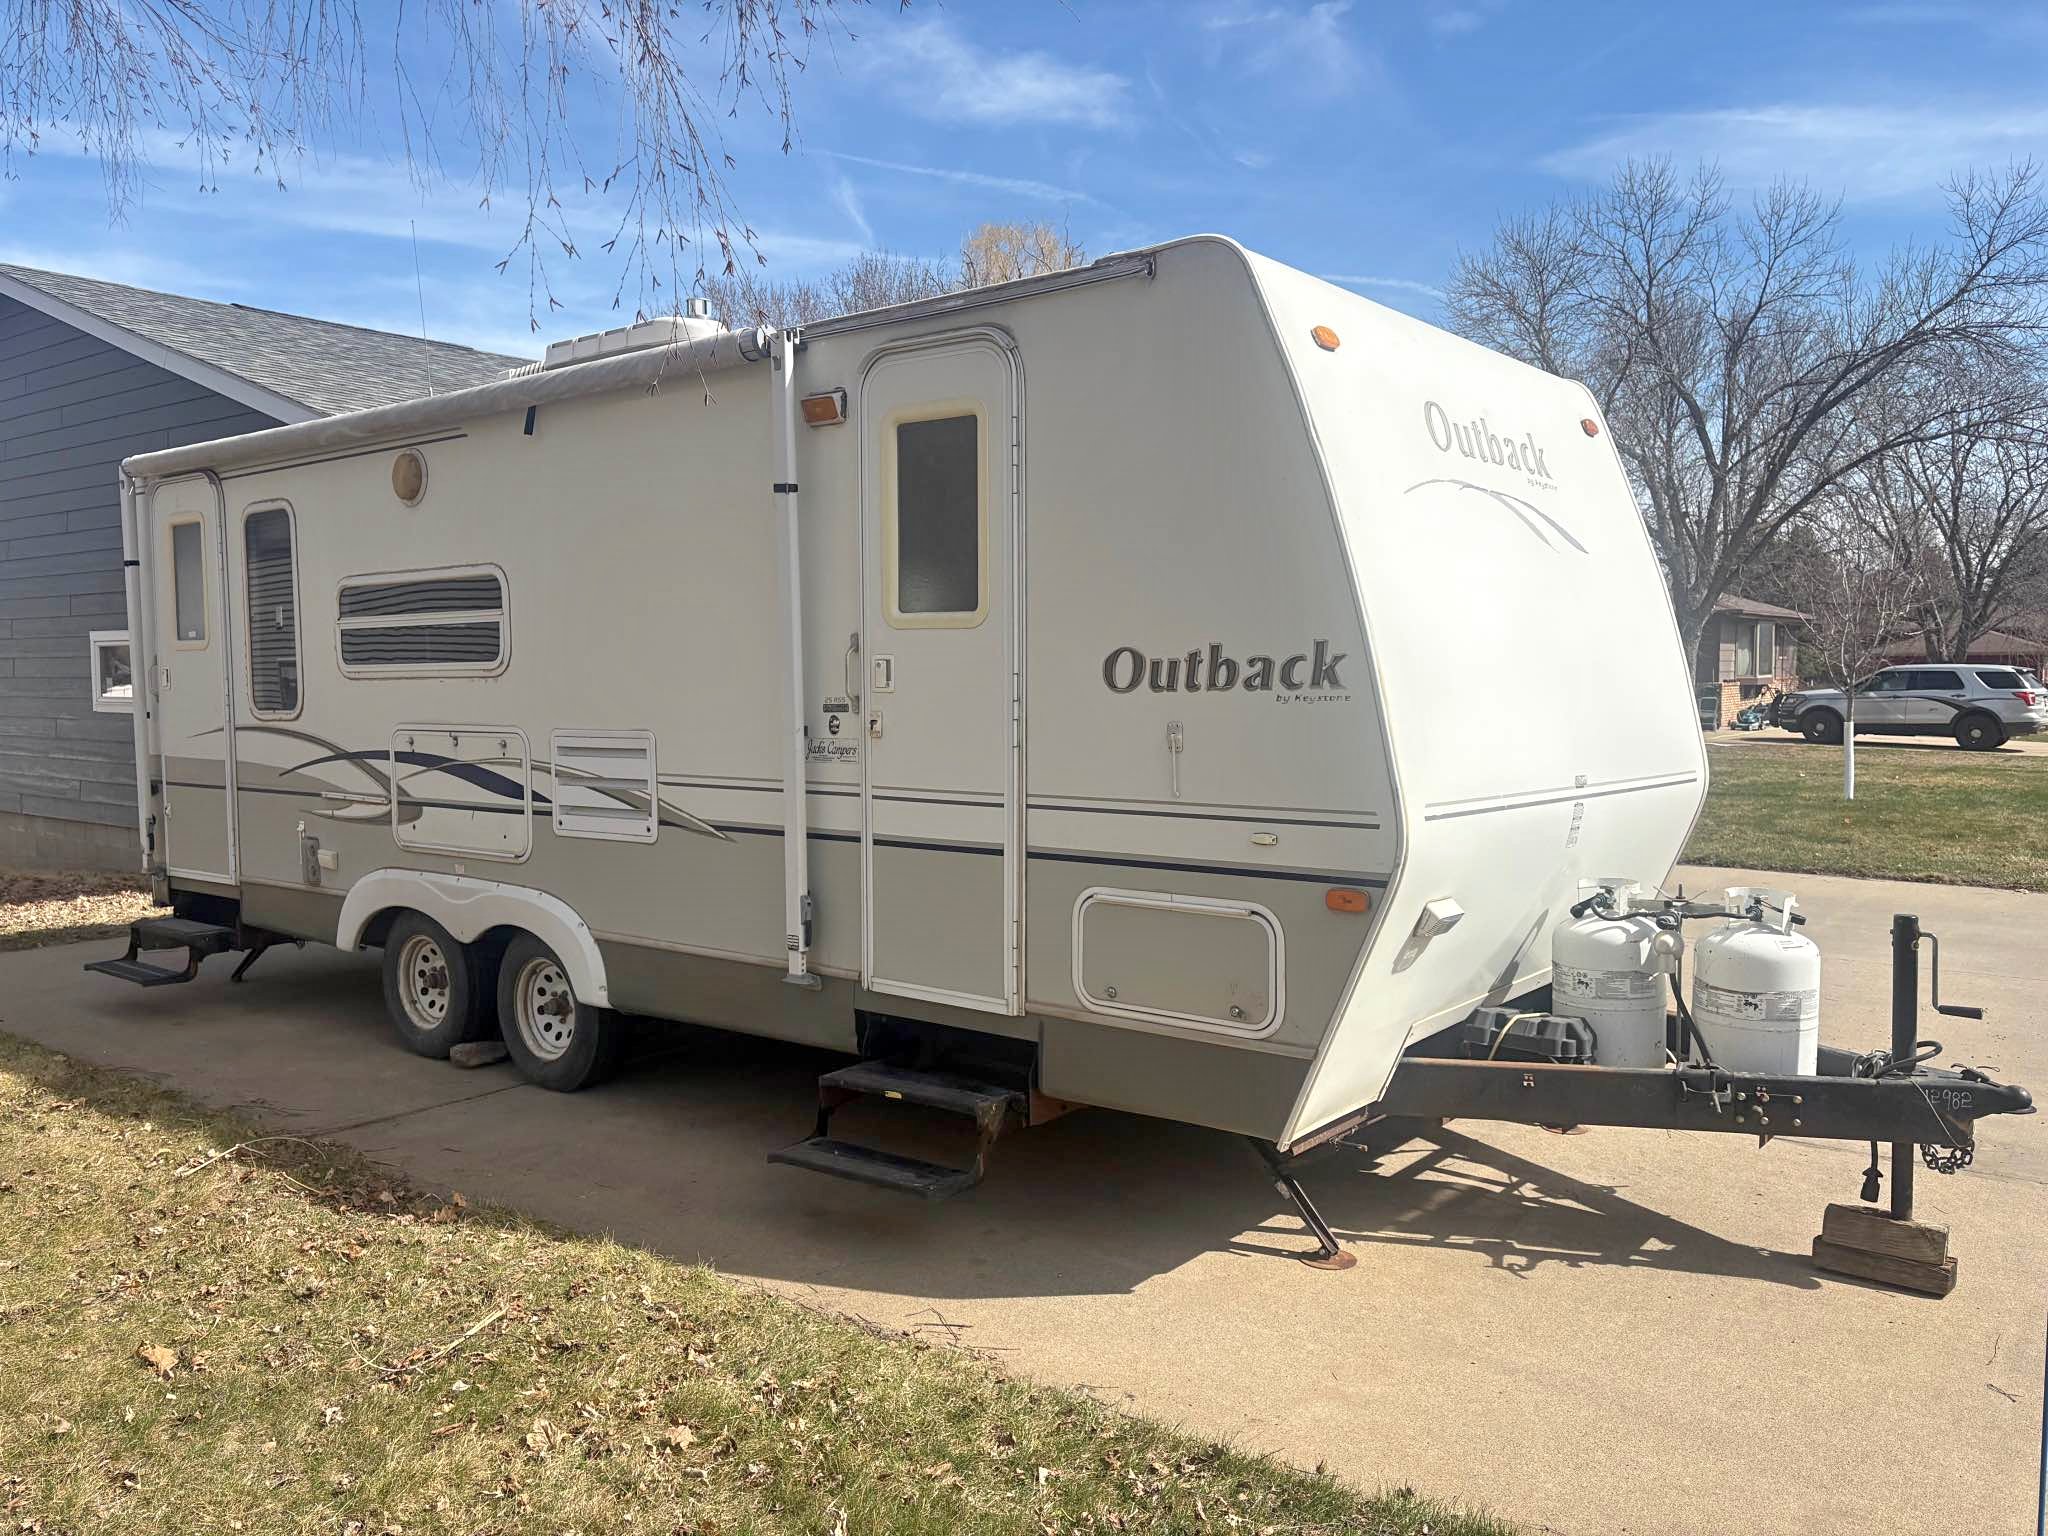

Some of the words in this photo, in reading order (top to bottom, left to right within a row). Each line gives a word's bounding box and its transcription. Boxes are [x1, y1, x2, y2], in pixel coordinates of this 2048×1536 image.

[1424, 400, 1553, 480] Outback
[1103, 639, 1348, 693] Outback
[1276, 694, 1290, 704] by
[1294, 694, 1352, 704] Keystone
[827, 741, 857, 760] Campers
